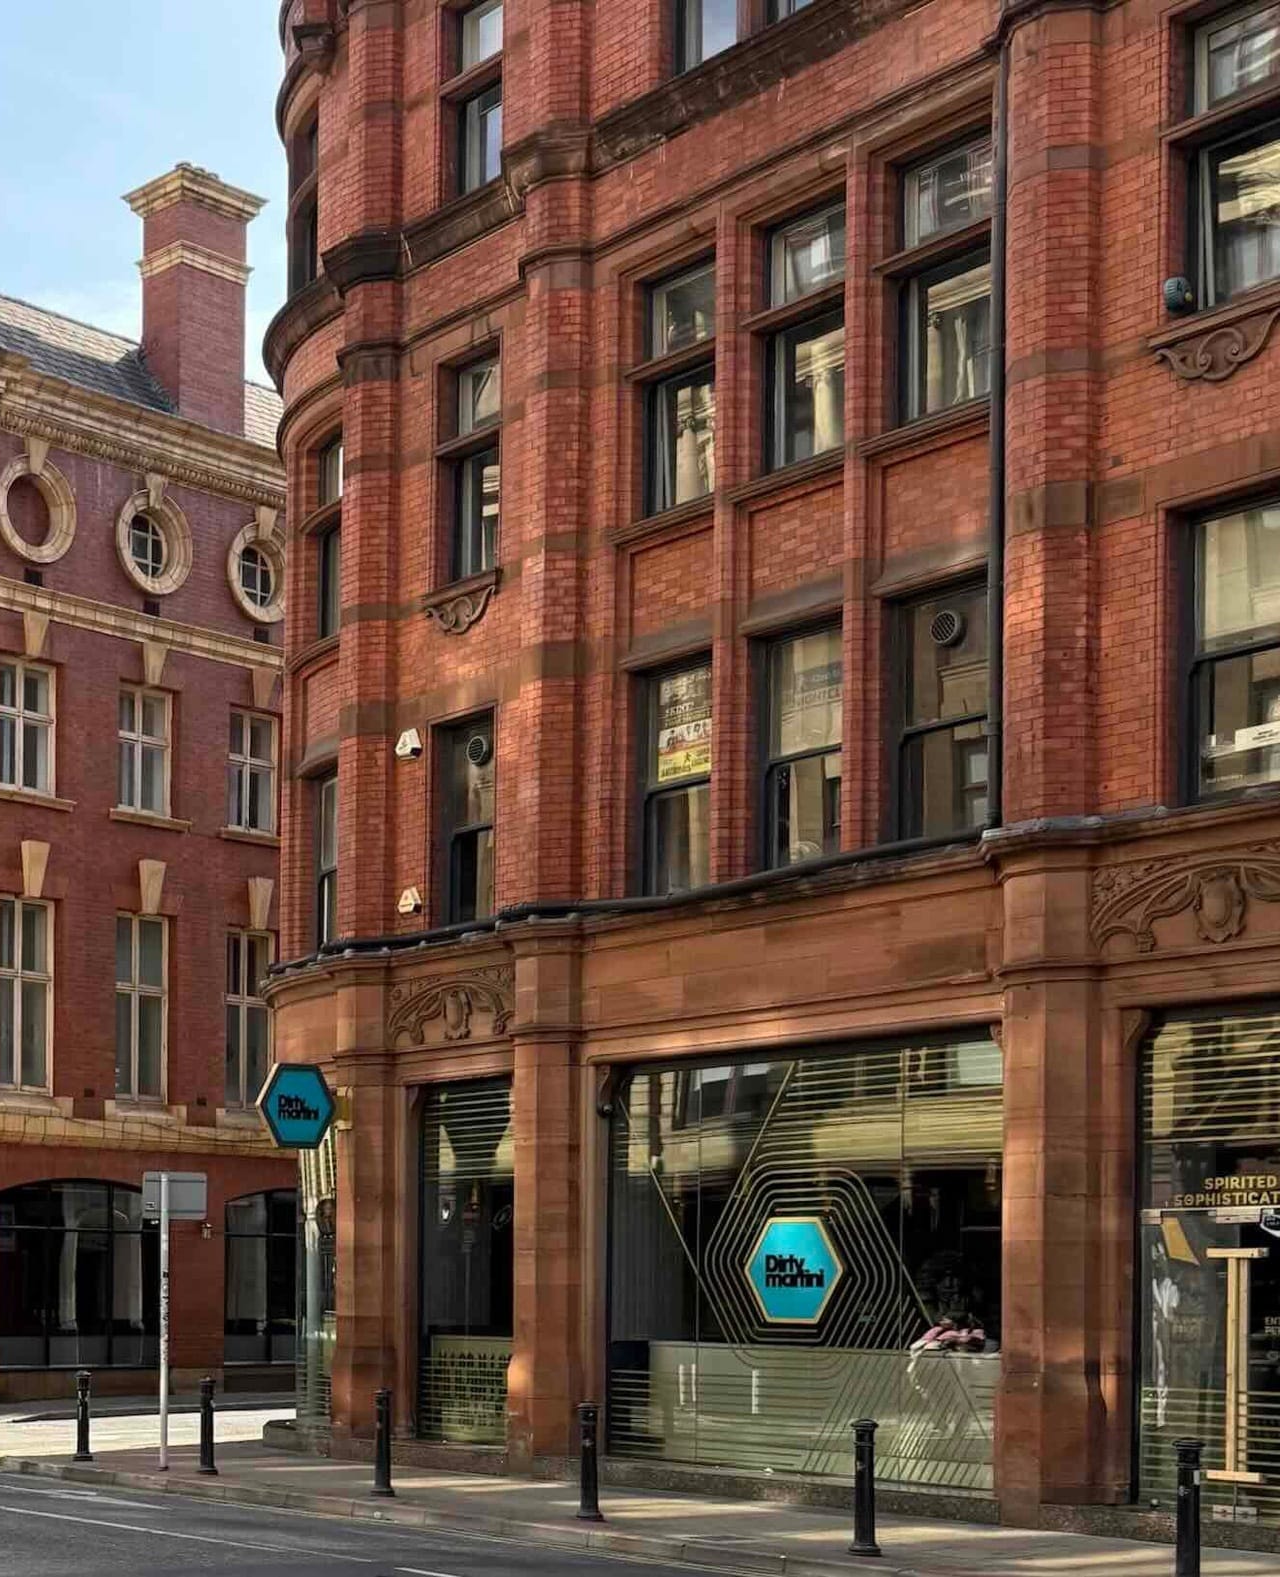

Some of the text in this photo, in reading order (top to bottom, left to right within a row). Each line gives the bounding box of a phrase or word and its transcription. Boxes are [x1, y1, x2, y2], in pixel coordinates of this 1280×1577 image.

[278, 1095, 307, 1111] Dirty
[278, 1106, 319, 1120] martini
[1204, 1175, 1277, 1190] SPIRITED
[766, 1254, 806, 1275] Dirty
[766, 1268, 824, 1287] martini
